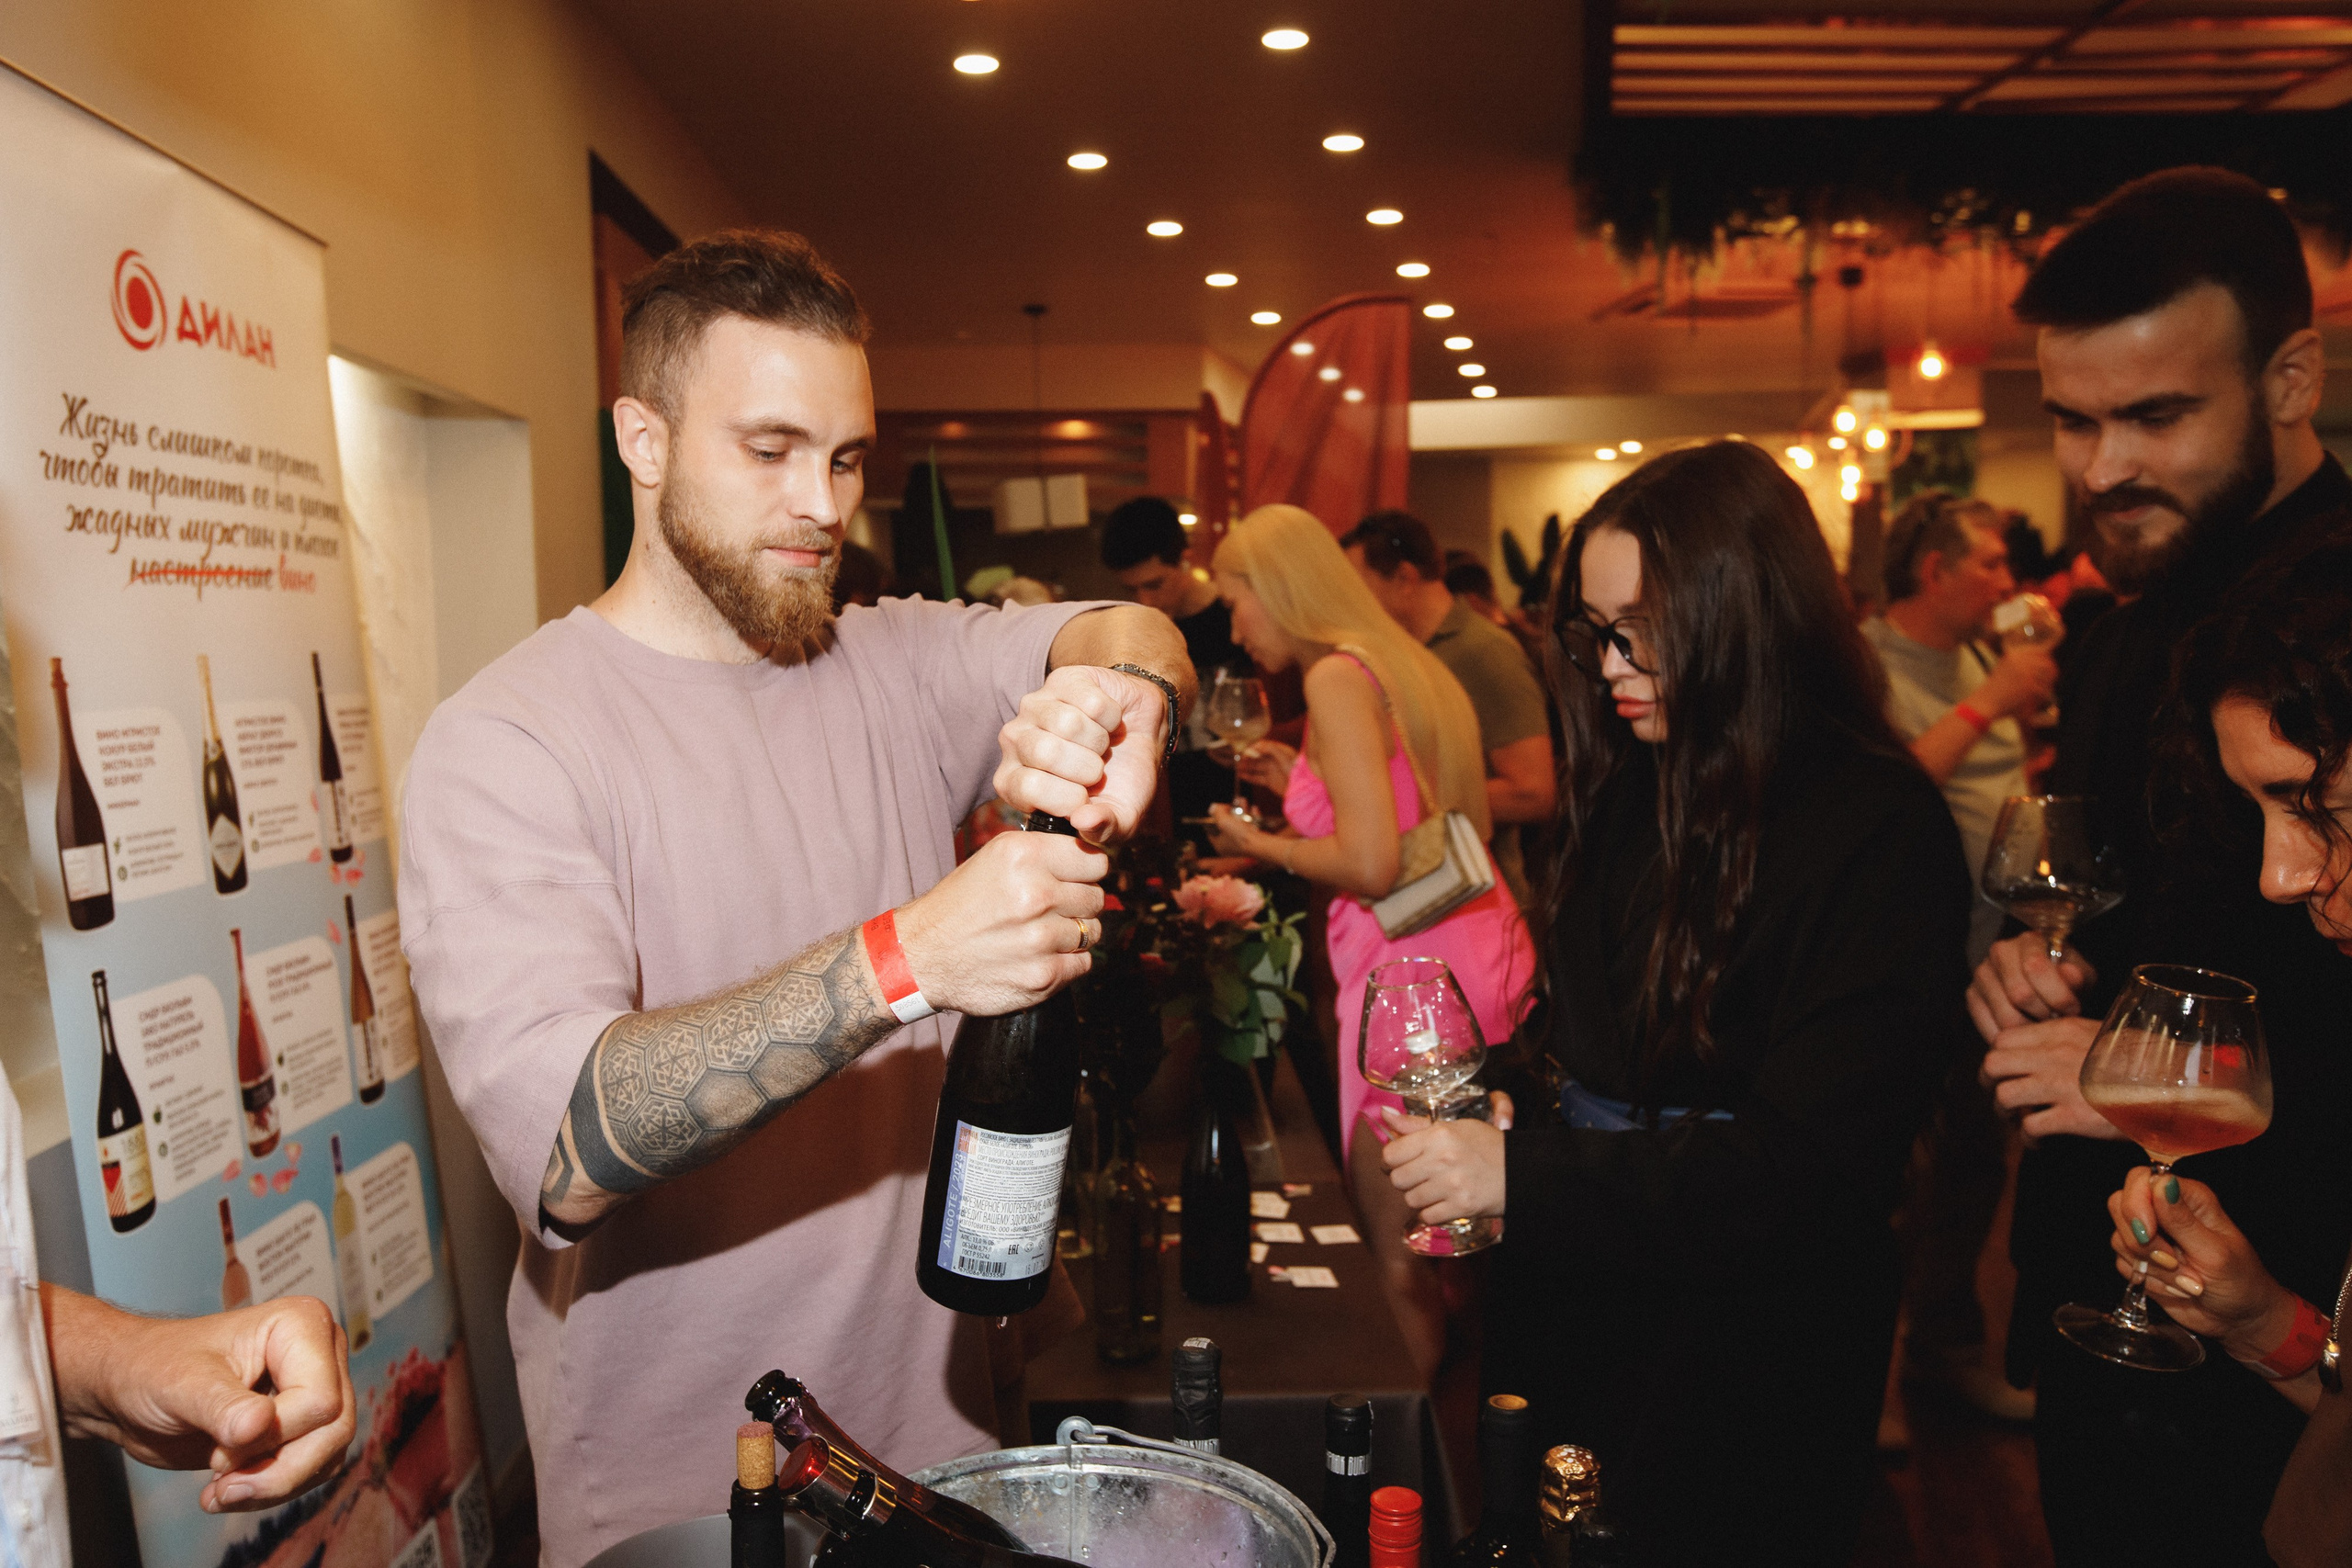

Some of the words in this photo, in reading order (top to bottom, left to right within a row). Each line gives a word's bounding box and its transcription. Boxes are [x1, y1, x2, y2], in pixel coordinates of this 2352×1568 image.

[177, 295, 277, 369] ДИЛАН
[60, 392, 139, 458] Жизнь
[148, 424, 253, 466] слишком
[40, 448, 119, 489] чтобы
[129, 465, 247, 509] тратить
[66, 503, 171, 554] жадных
[179, 518, 275, 562] мужчин
[978, 1154, 988, 1162] СОРТ
[989, 1156, 1014, 1167] ВИНОГРАДА:
[943, 1191, 958, 1248] ALIGOTE
[953, 1153, 963, 1183] 2023
[959, 1218, 998, 1232] ИЗГОТОВИТЕЛЬ:
[961, 1205, 982, 1221] ВРЕДИТ
[983, 1212, 1011, 1224] ВАШЕМУ
[962, 1195, 1001, 1213] ЧРЕЗМЕРНОЕ
[1001, 1200, 1041, 1213] УПОТРЕБЛЕНИЕ
